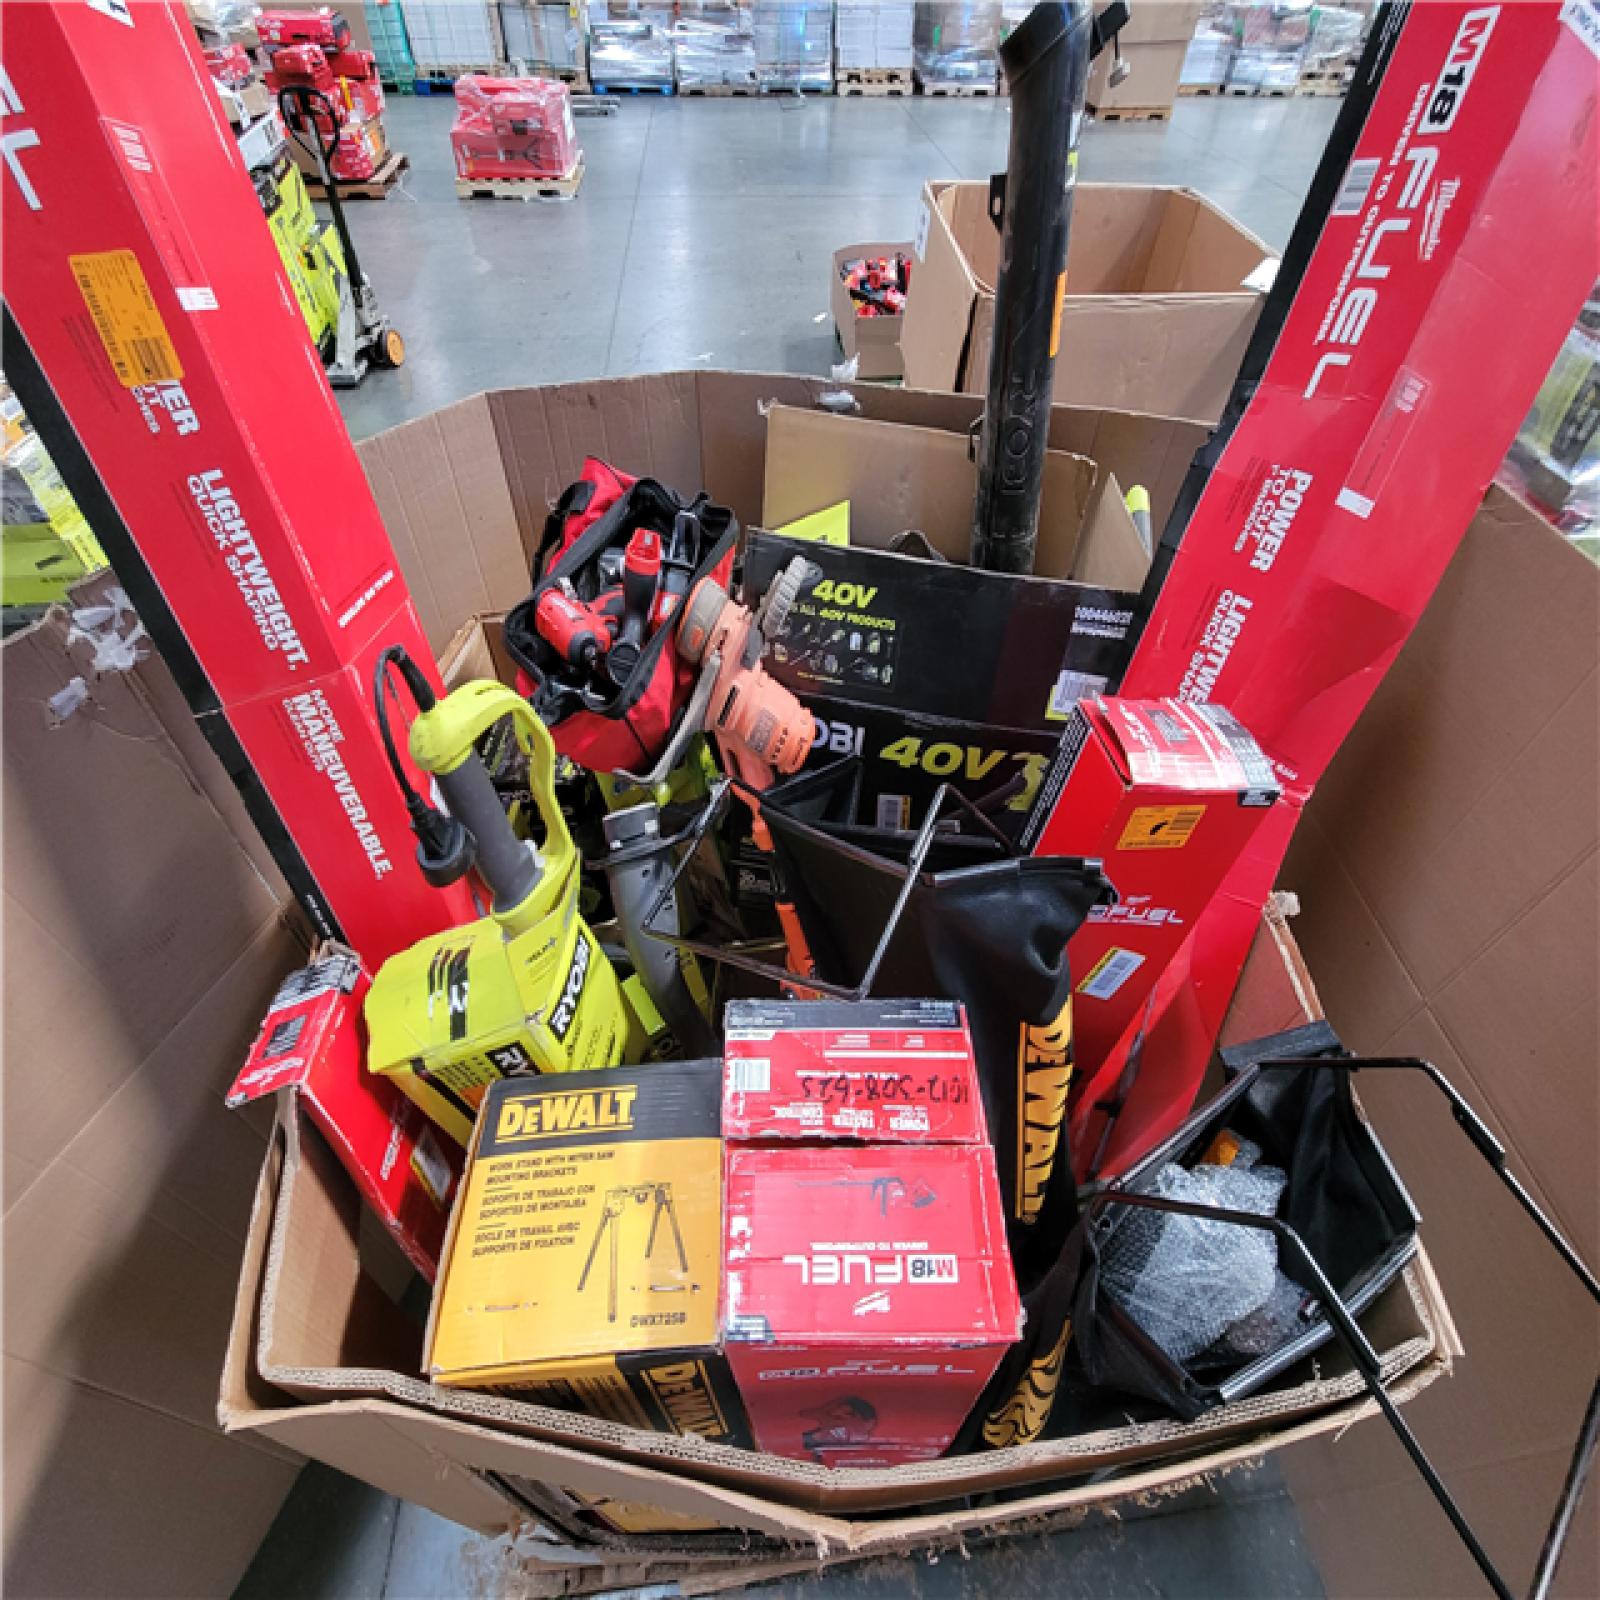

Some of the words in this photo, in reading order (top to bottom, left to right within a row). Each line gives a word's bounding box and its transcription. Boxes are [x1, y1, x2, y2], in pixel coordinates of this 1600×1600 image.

[1420, 9, 1497, 131] M18
[1305, 146, 1439, 399] FUEL
[187, 474, 233, 551] QUICK
[225, 553, 280, 651] SHAPING
[200, 468, 310, 671] LIGHTWEIGHT.
[1249, 469, 1314, 572] POWER
[811, 579, 879, 608] 40V
[1199, 589, 1234, 649] QUICK
[290, 693, 394, 881] MANEUVERABLE.
[879, 736, 1006, 781] 40V
[497, 1089, 638, 1139] DEWALT
[1019, 1000, 1074, 1222] DEWALT
[782, 1253, 904, 1284] FUEL
[907, 1253, 959, 1284] M18
